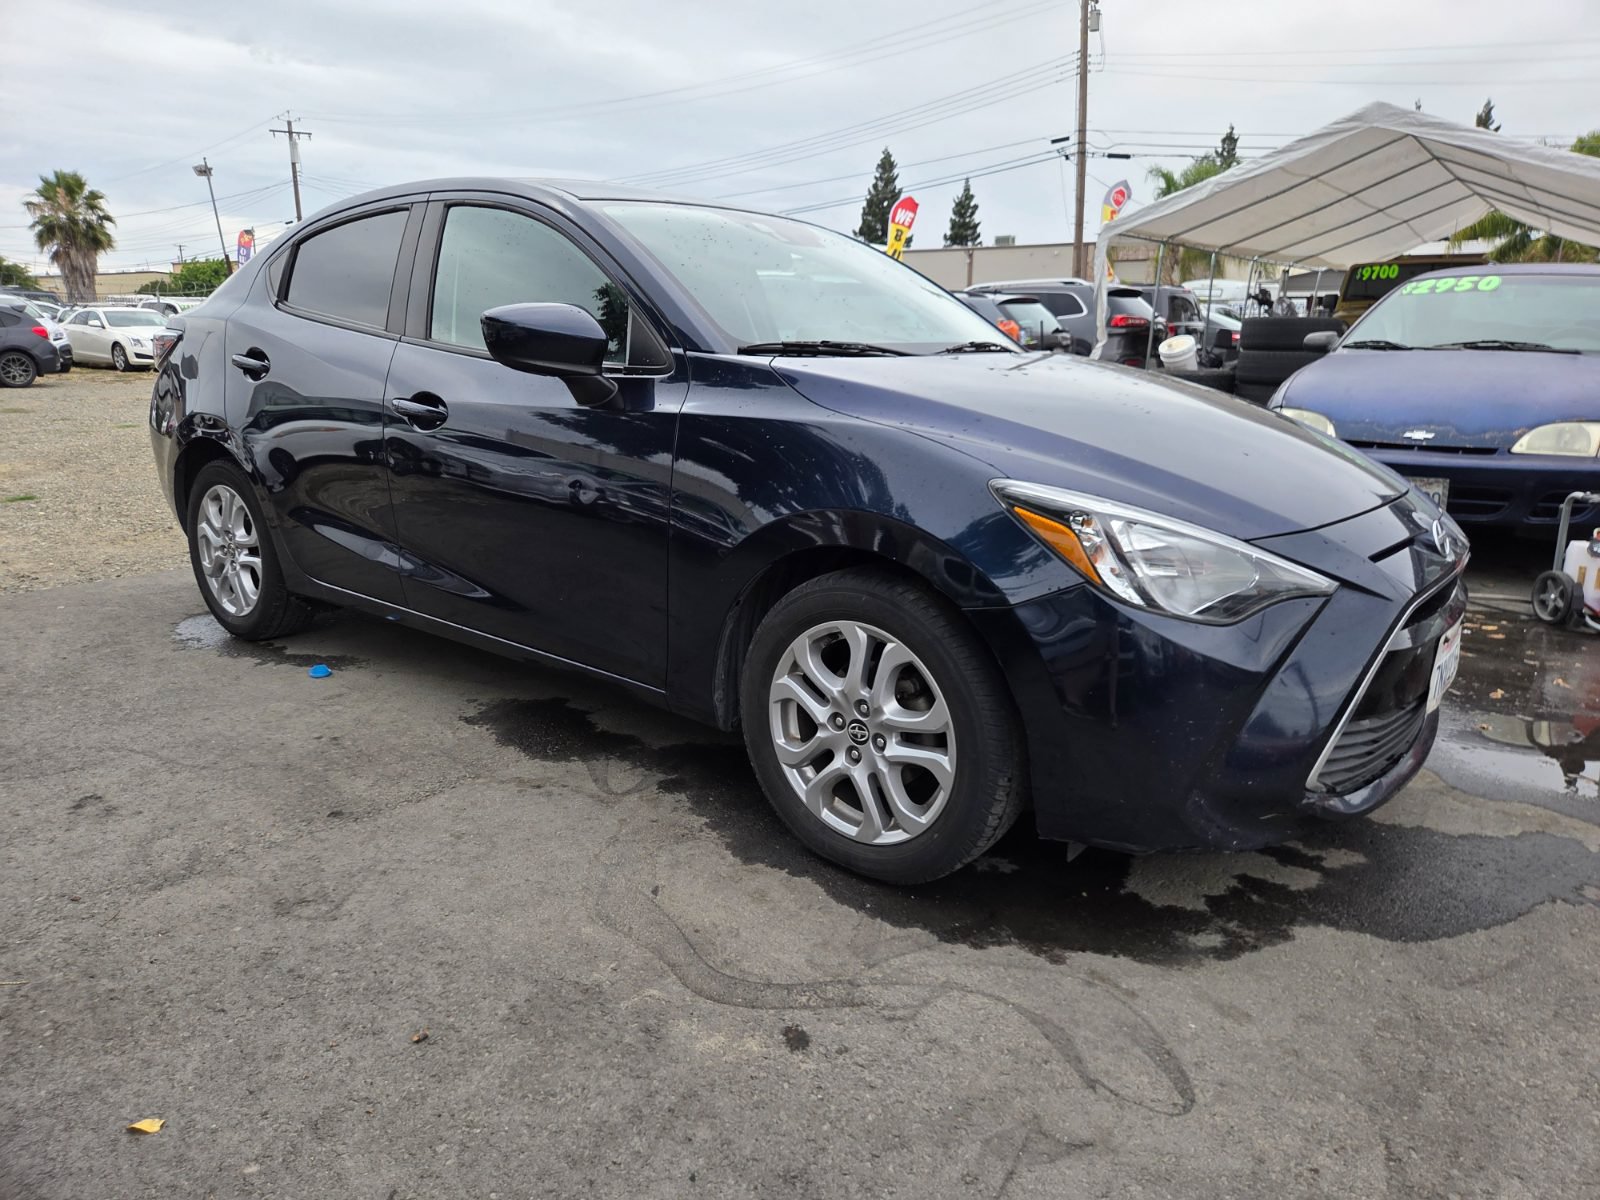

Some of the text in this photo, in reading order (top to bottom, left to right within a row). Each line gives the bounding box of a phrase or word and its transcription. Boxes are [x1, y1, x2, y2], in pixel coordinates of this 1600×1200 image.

[895, 208, 915, 226] WE
[1356, 263, 1399, 281] $9700
[1402, 275, 1501, 295] $2950
